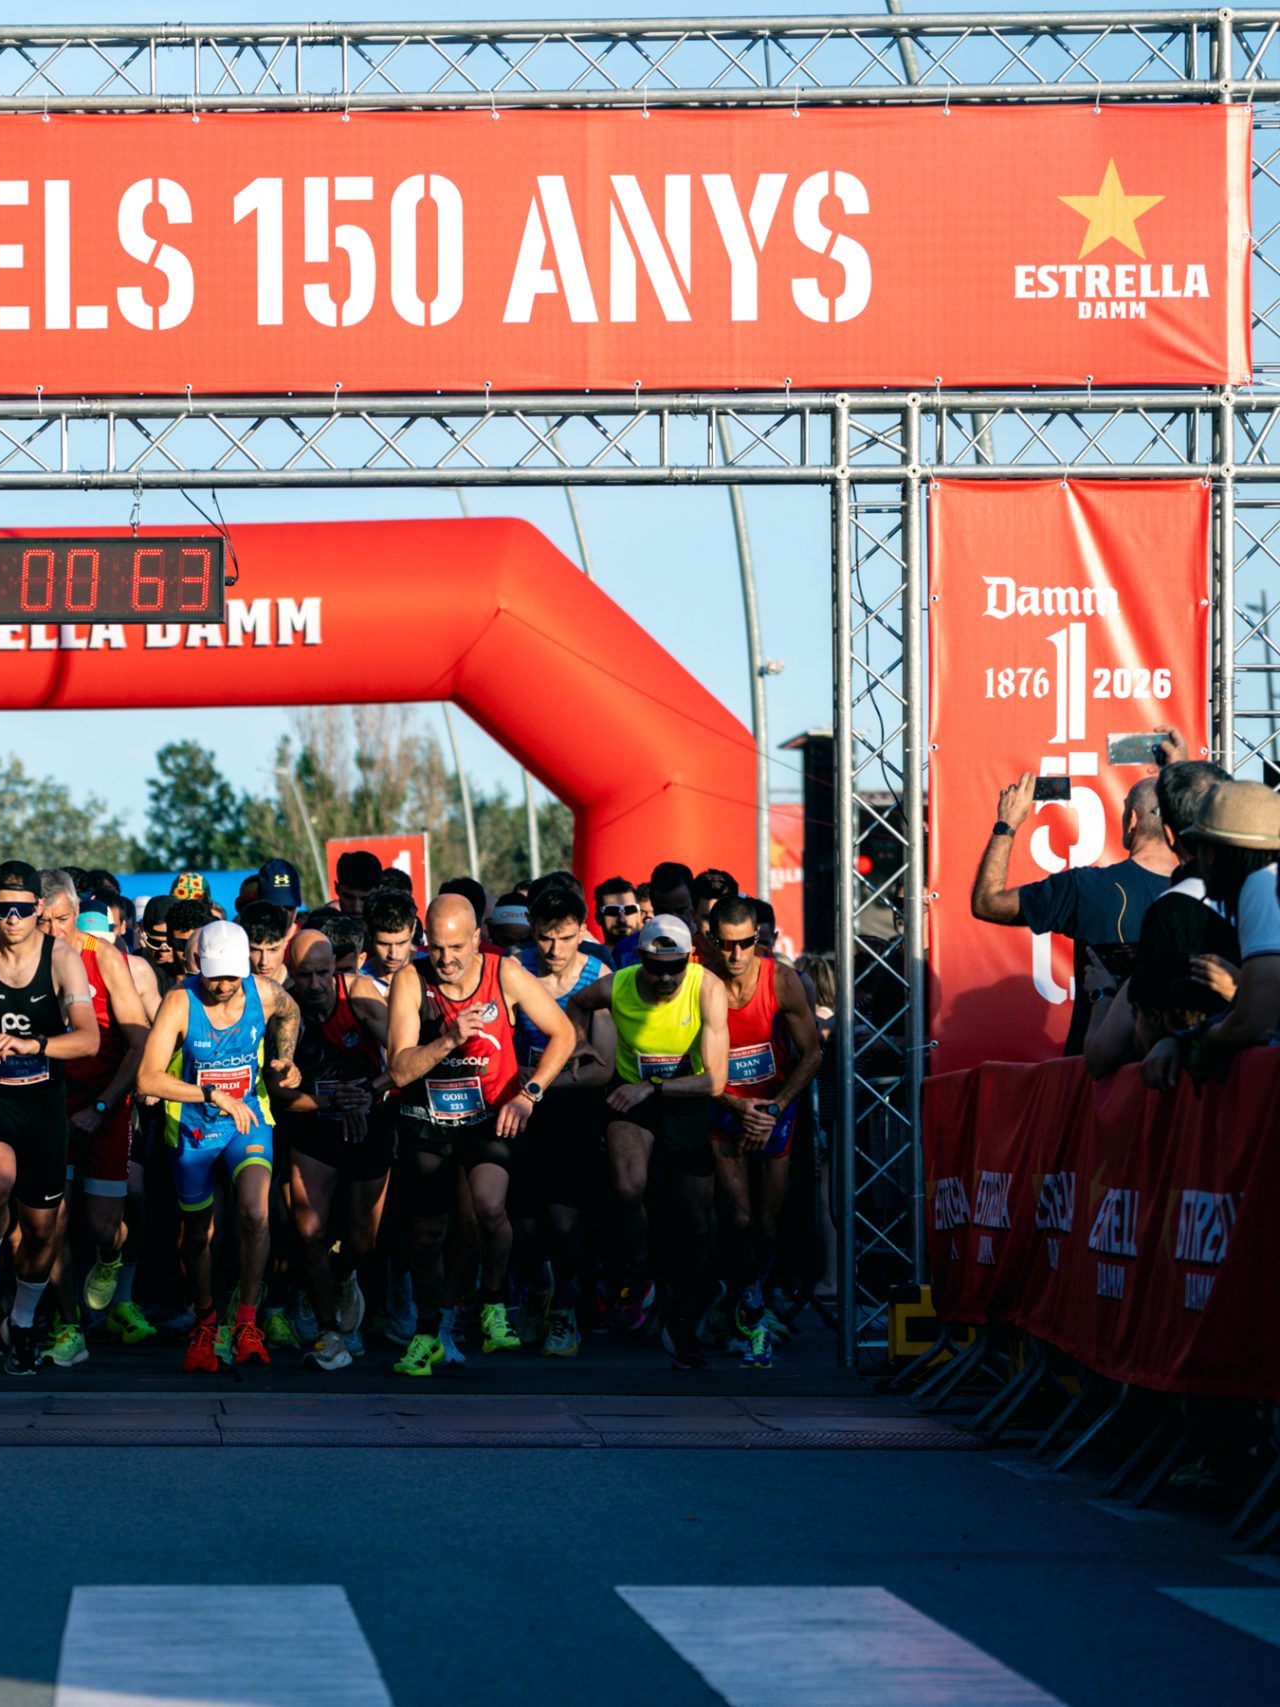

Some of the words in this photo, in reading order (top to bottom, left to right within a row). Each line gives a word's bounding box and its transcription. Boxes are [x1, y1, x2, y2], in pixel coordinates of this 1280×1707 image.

[233, 174, 464, 327] 150
[502, 171, 872, 323] ANYS
[1014, 264, 1210, 299] ESTRELLA
[1078, 301, 1146, 319] DAMM
[21, 549, 100, 613] 00
[132, 548, 211, 612] 63
[981, 575, 1120, 620] Damm
[985, 667, 1049, 699] 1876
[1093, 667, 1172, 699] 2026
[735, 1058, 761, 1070] JOAN
[214, 1082, 240, 1090] ORDI
[442, 1092, 468, 1101] GORI
